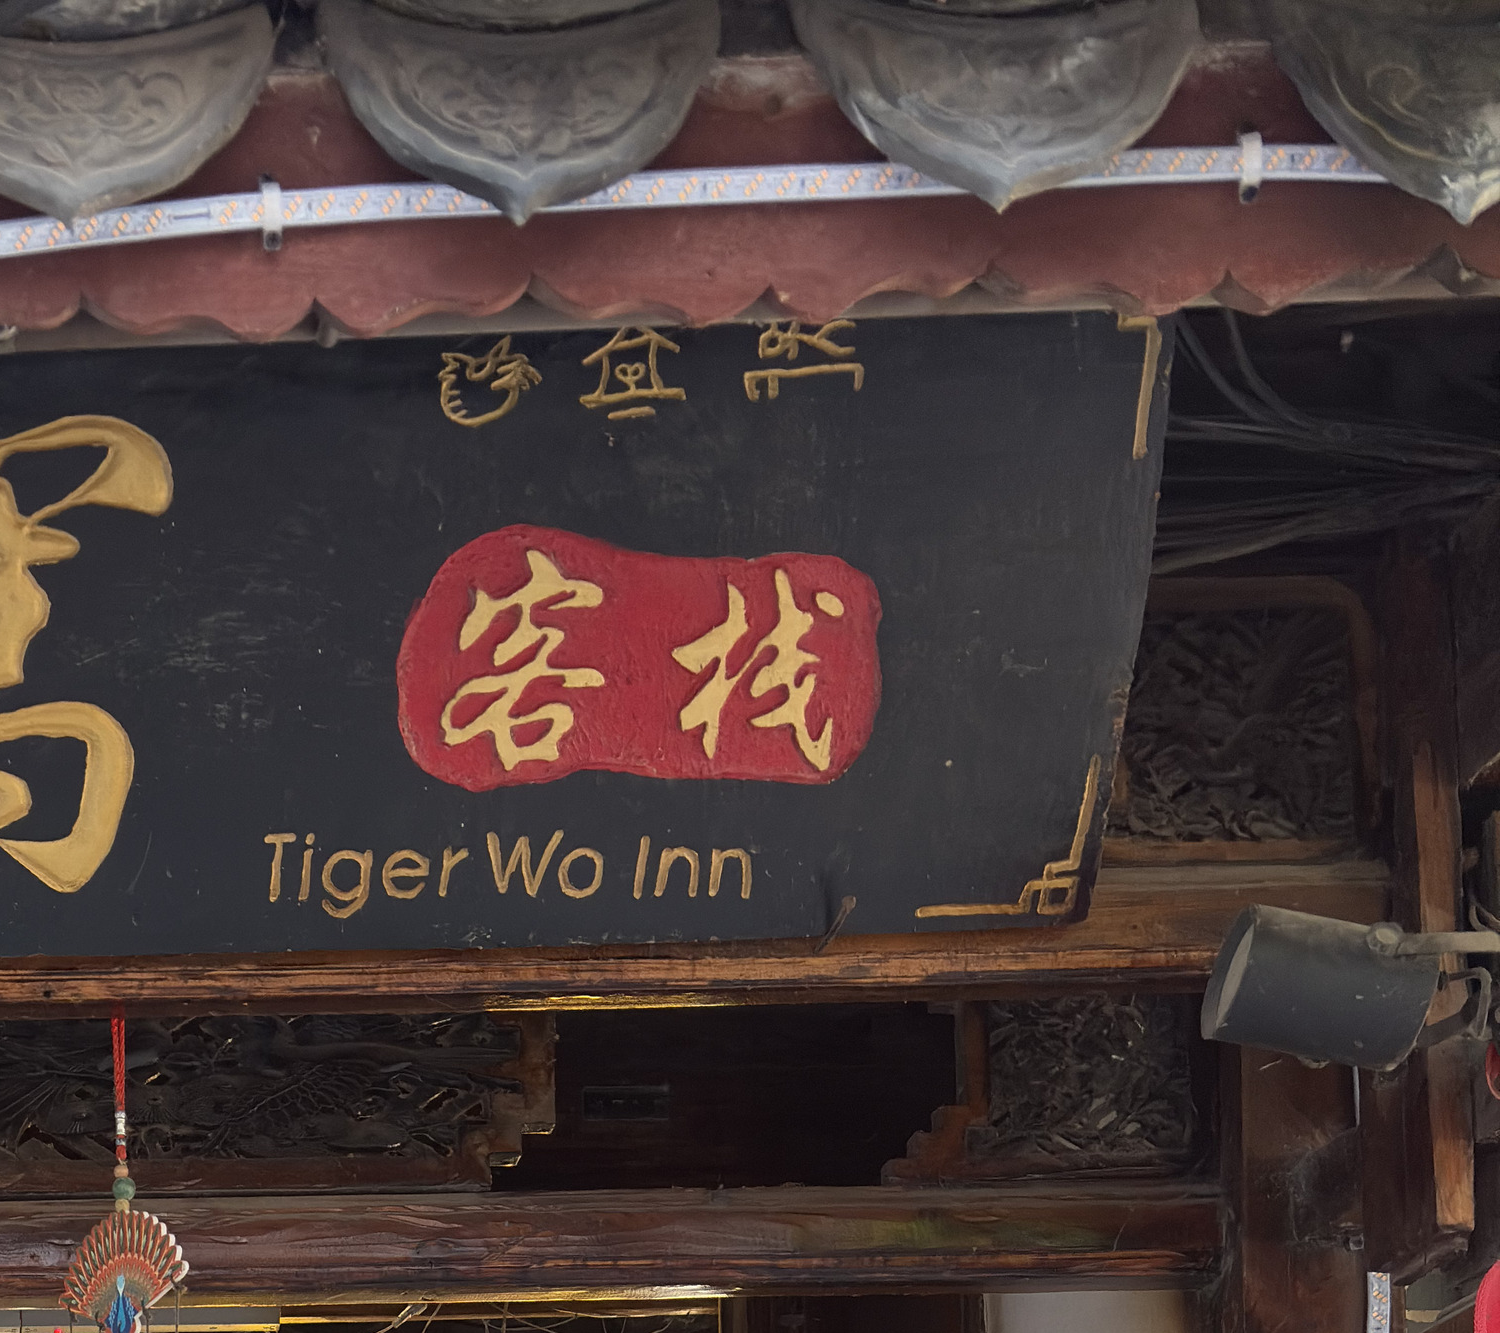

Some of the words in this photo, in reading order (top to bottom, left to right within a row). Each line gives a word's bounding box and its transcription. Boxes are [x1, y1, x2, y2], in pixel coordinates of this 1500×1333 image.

[440, 549, 845, 773] 客栈
[263, 831, 469, 919] Tiger
[486, 828, 605, 900] Wo
[632, 834, 753, 900] Inn
